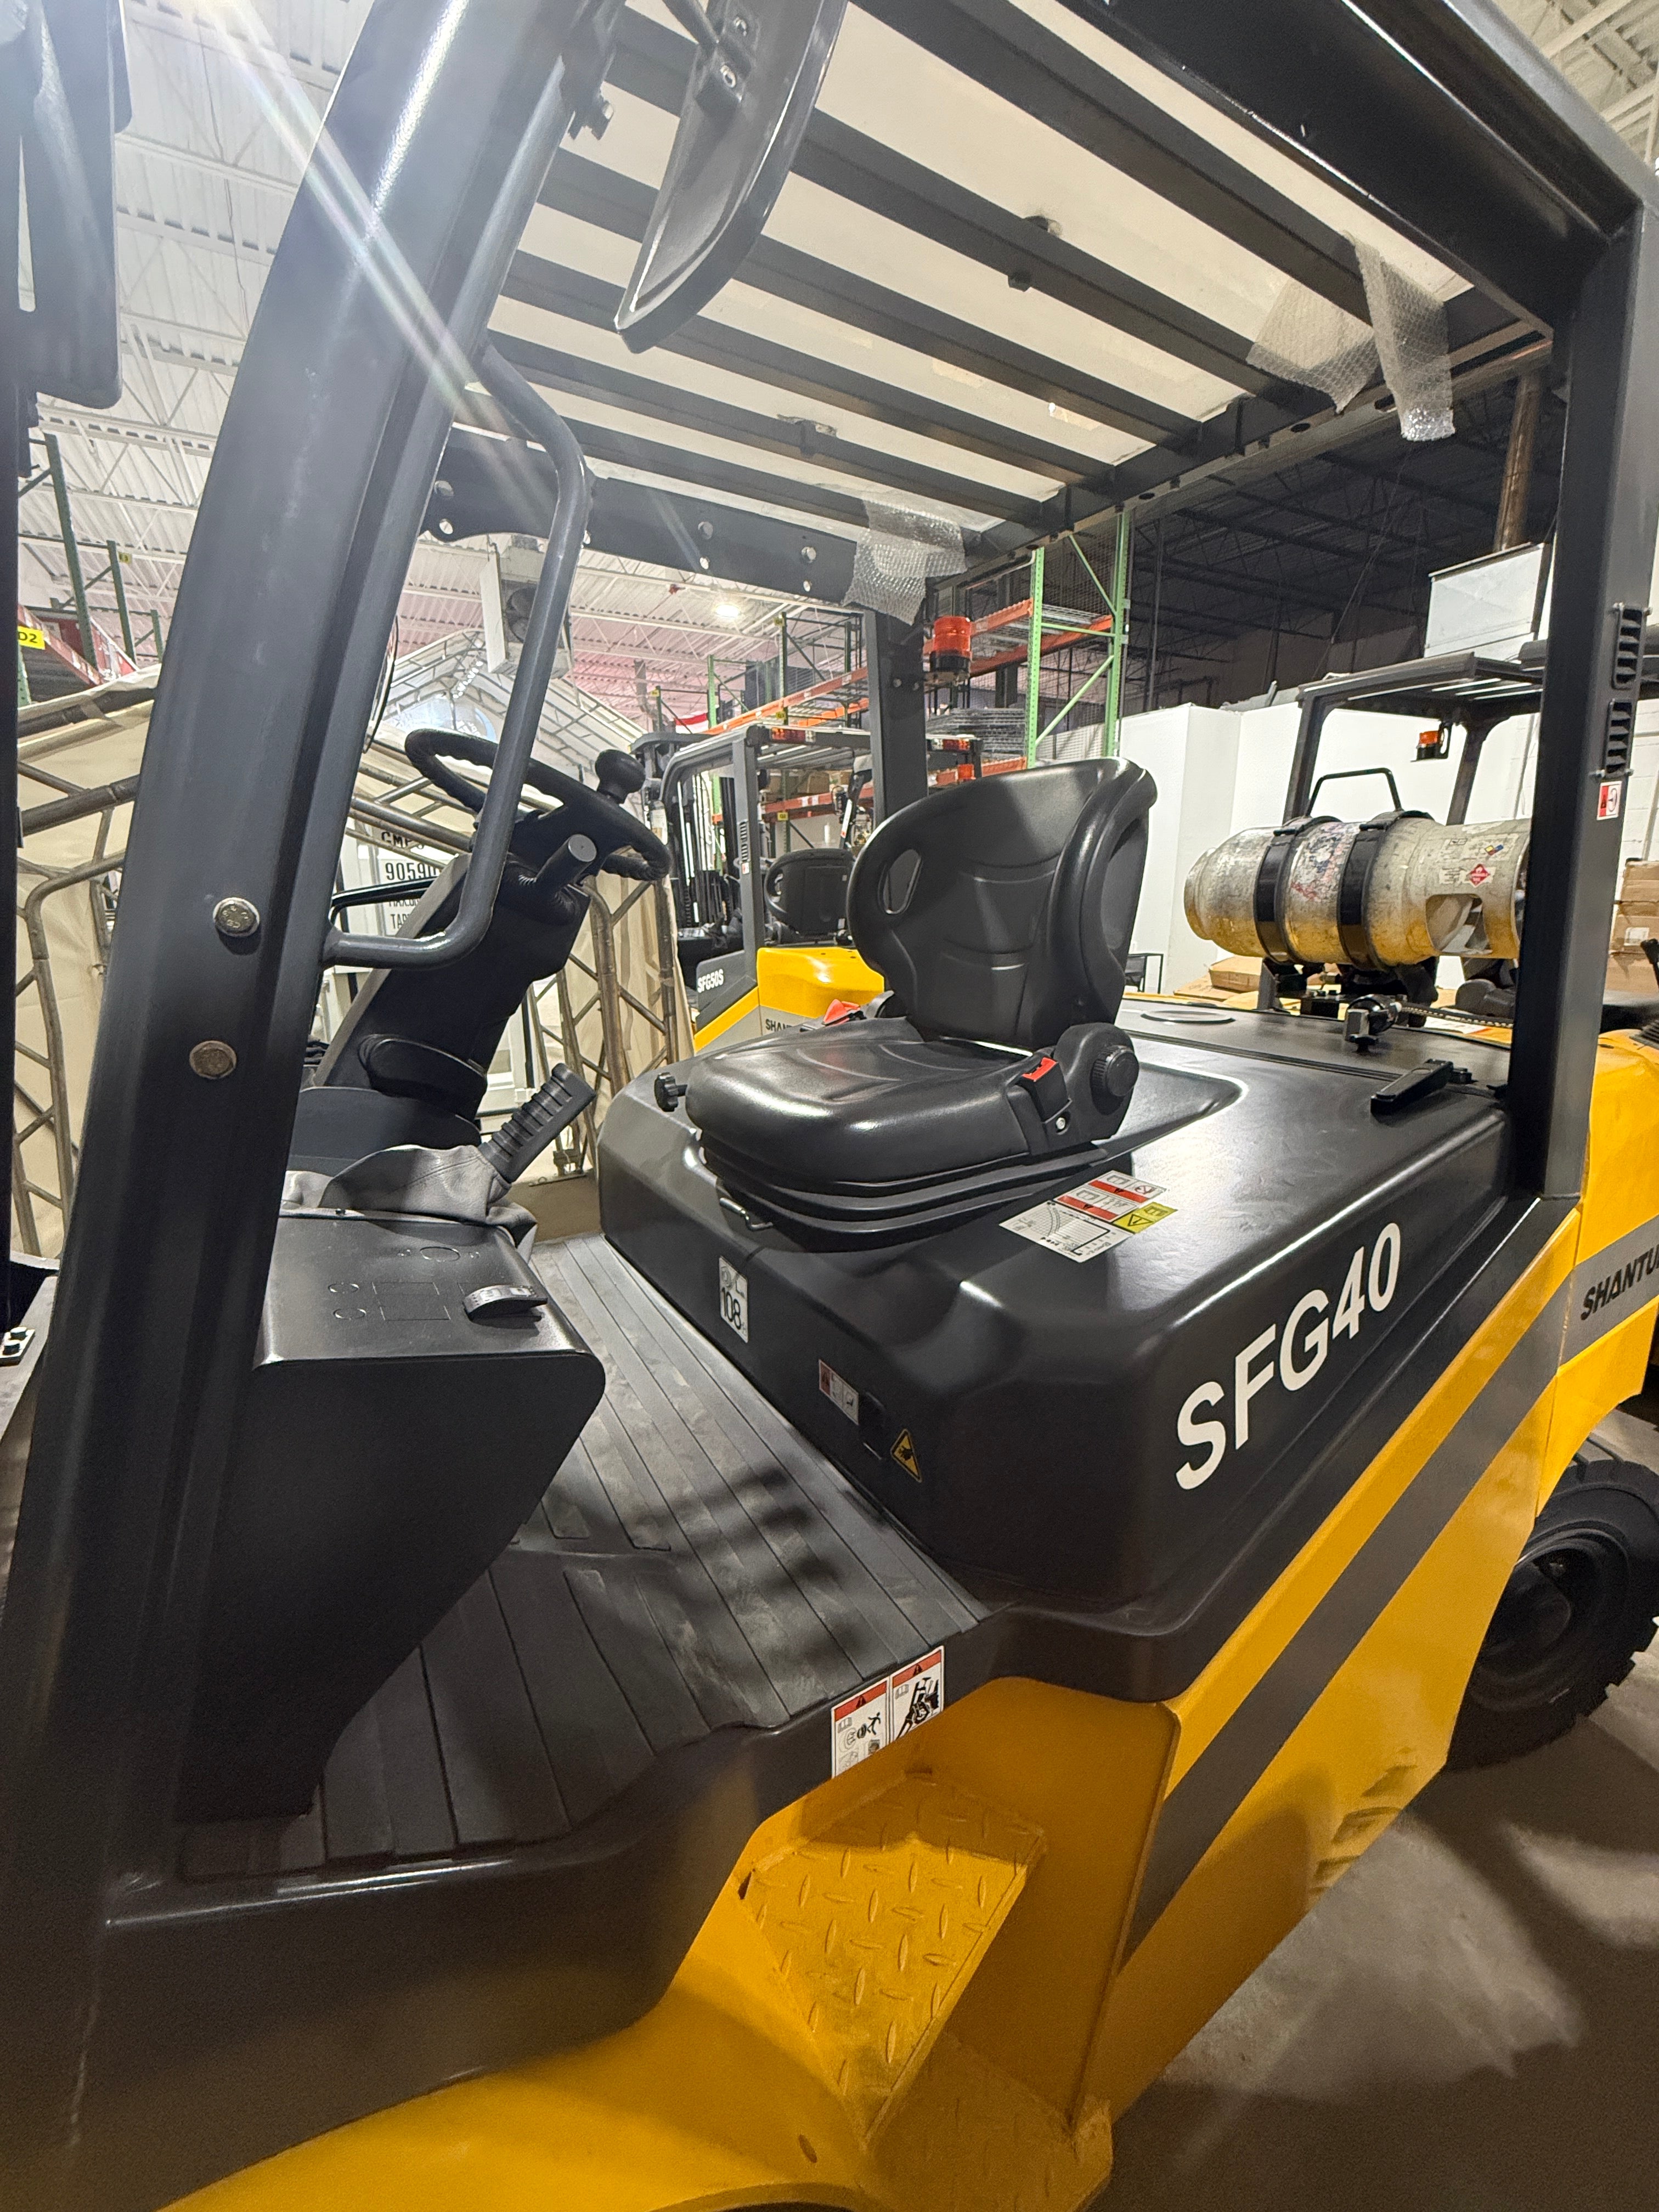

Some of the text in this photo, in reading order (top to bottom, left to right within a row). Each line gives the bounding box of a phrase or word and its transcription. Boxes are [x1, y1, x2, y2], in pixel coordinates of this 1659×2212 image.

[18, 631, 38, 644] D2
[697, 968, 724, 993] SFG50S
[765, 1018, 793, 1032] SHA
[1580, 1243, 1659, 1321] SHANTU
[721, 1286, 741, 1330] 108
[1176, 1223, 1401, 1490] SFG40
